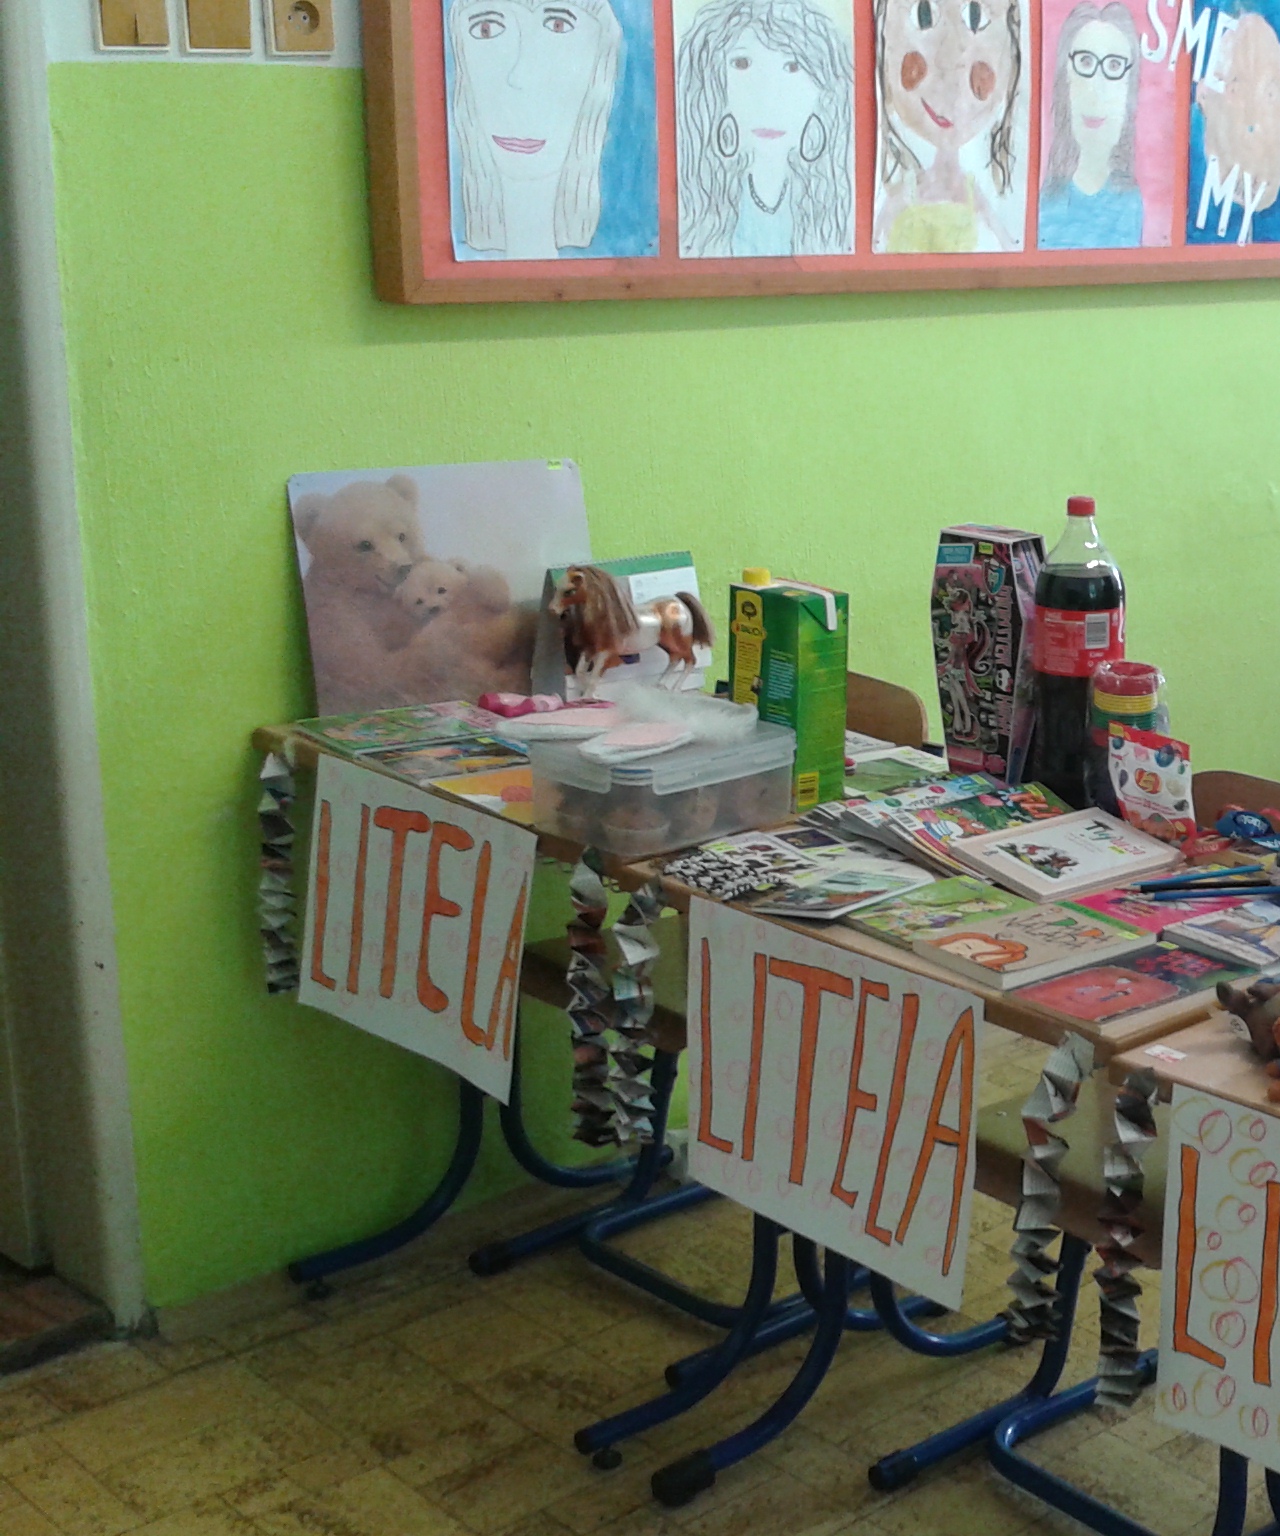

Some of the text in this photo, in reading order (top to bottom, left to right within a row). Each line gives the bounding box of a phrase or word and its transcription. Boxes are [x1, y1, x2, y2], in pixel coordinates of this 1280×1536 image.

[1196, 155, 1267, 247] MY
[311, 800, 528, 1062] LITELA
[697, 936, 974, 1276] LITELA
